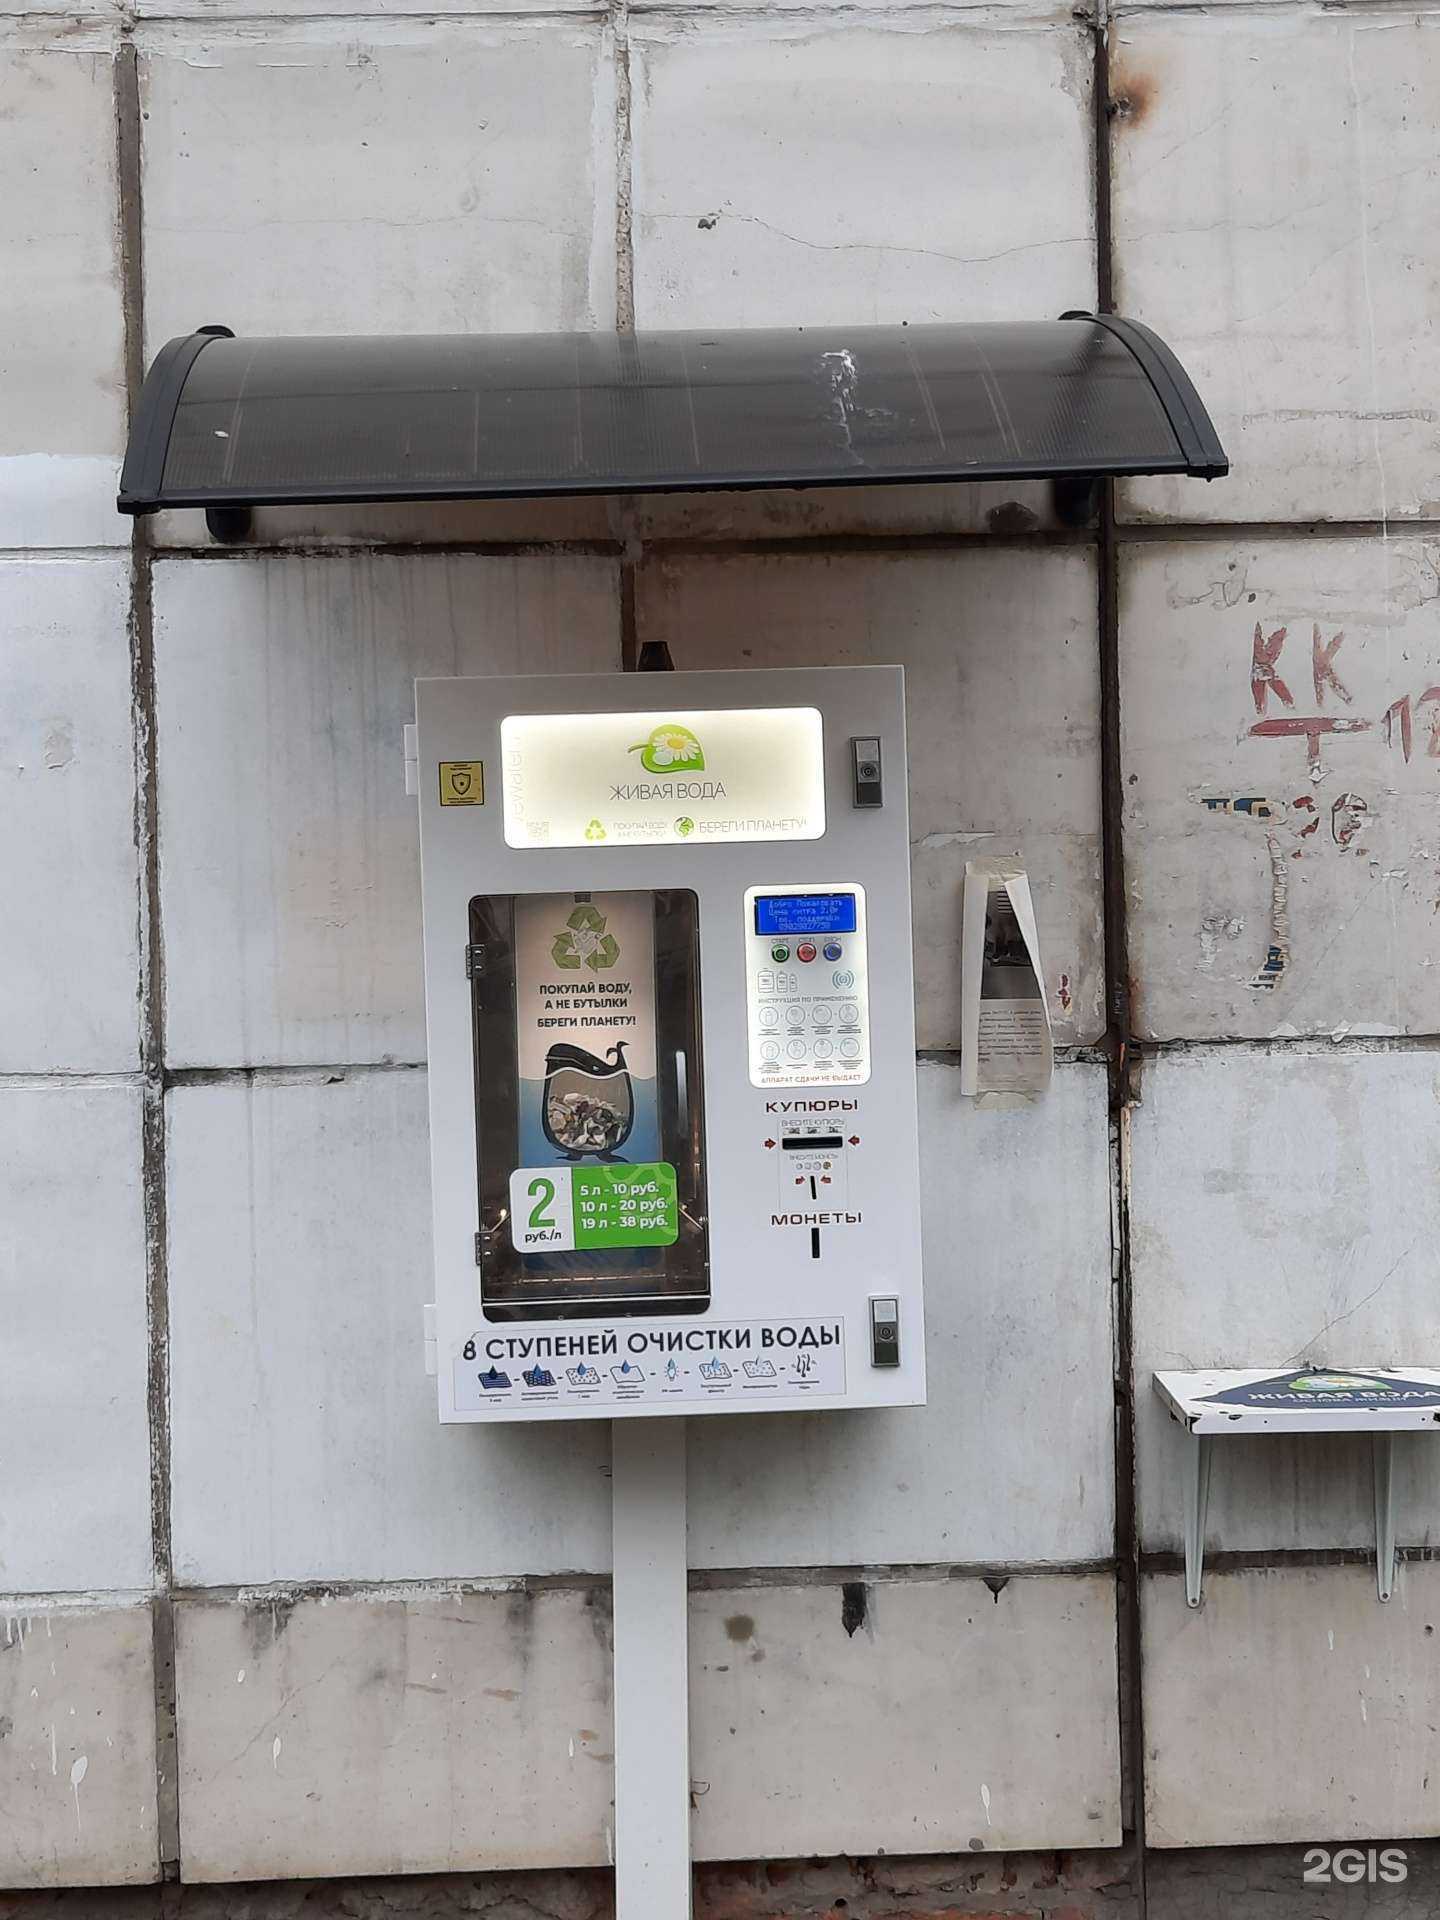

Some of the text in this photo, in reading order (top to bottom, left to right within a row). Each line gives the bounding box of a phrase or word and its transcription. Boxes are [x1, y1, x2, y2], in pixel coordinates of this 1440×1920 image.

[609, 781, 727, 801] ЖИВАЯ ВОДА
[699, 819, 745, 834] БЕРЕГИ
[539, 981, 632, 995] ПОКУПАЙ ВОДУ,
[544, 997, 628, 1010] А НЕ БУТЫЛКИ
[537, 1015, 636, 1028] БЕРЕГИ ПЛАНЕТУ!
[761, 1075, 793, 1084] АППАРАТ
[794, 1075, 820, 1083] СДАЧИ
[765, 1099, 858, 1113] КУПЮРЫ
[580, 1185, 589, 1196] 5
[591, 1186, 600, 1196] л
[612, 1183, 627, 1195] 10
[630, 1181, 659, 1197] руб.
[527, 1177, 556, 1228] 2
[580, 1201, 595, 1213] 10
[599, 1202, 608, 1212] л
[619, 1199, 637, 1211] 20
[640, 1197, 668, 1214] руб.
[581, 1218, 596, 1229] 19
[599, 1219, 608, 1229] л
[619, 1216, 637, 1228] 38
[640, 1214, 668, 1231] руб.
[771, 1211, 862, 1226] МОНЕТЫ
[524, 1228, 562, 1243] руб./л
[462, 1324, 841, 1361] 8 СТУПЕНЕЙ ОЧИСТКИ ВОДЫ
[1248, 1390, 1440, 1400] ЖИВАЯ ВОДА
